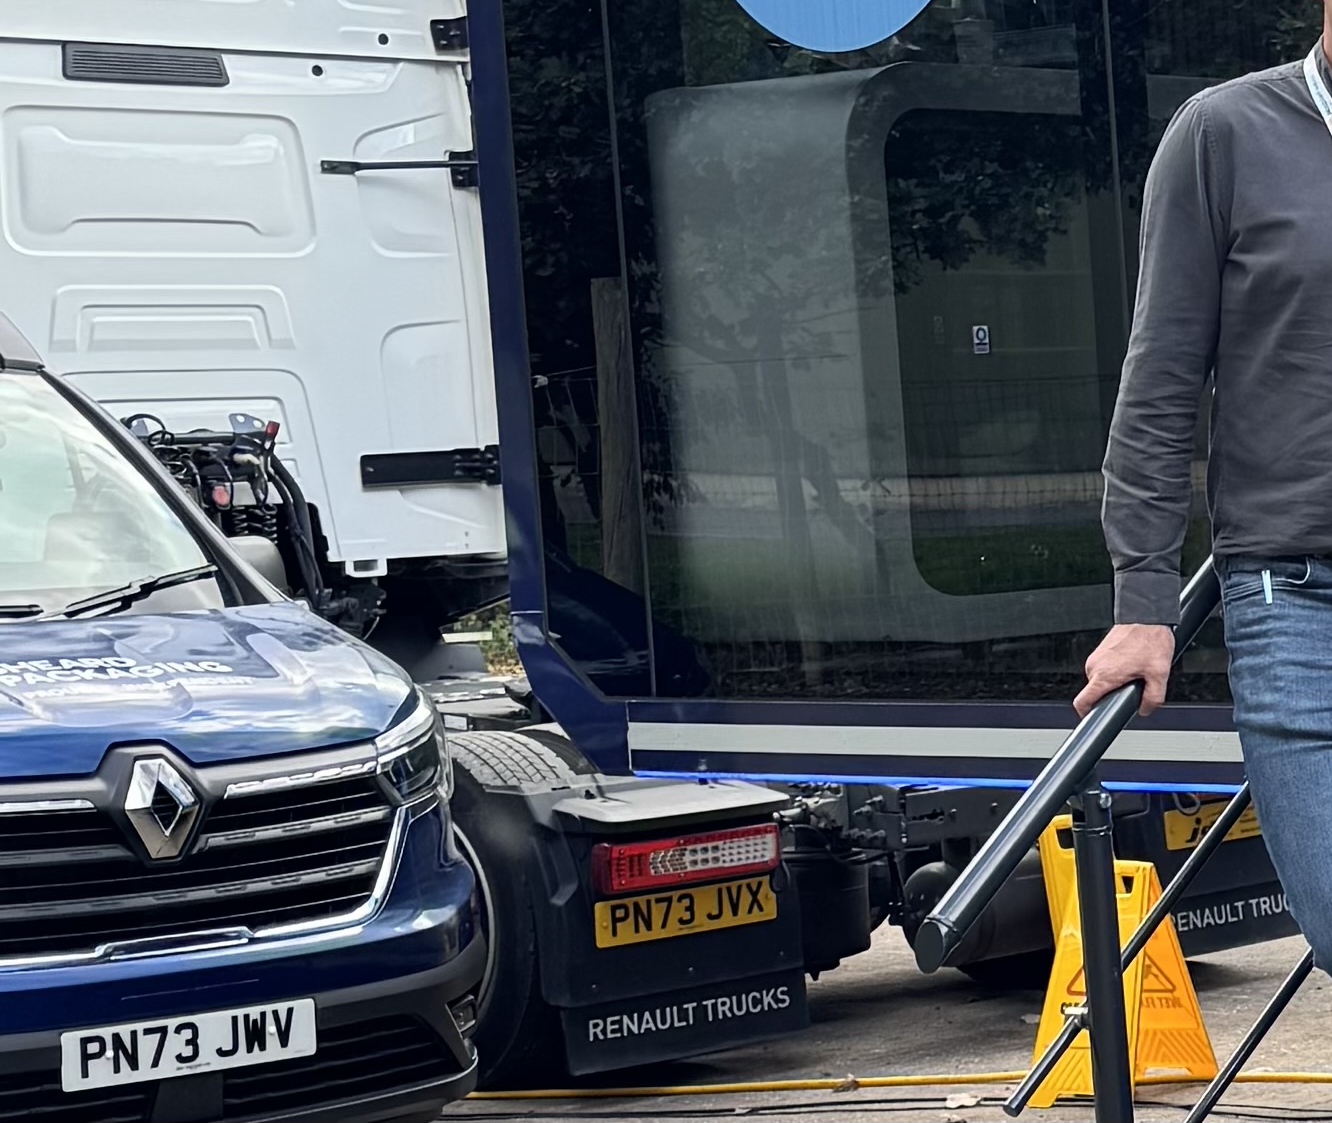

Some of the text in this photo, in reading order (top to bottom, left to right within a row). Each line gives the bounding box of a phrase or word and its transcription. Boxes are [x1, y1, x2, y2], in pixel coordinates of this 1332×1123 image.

[0, 661, 233, 687] PACKAGING
[610, 881, 764, 937] PN73 JVX
[1172, 901, 1245, 931] ENAULT
[588, 986, 790, 1042] RENAULT TRUCKS
[79, 1006, 294, 1079] PN73 JWV
